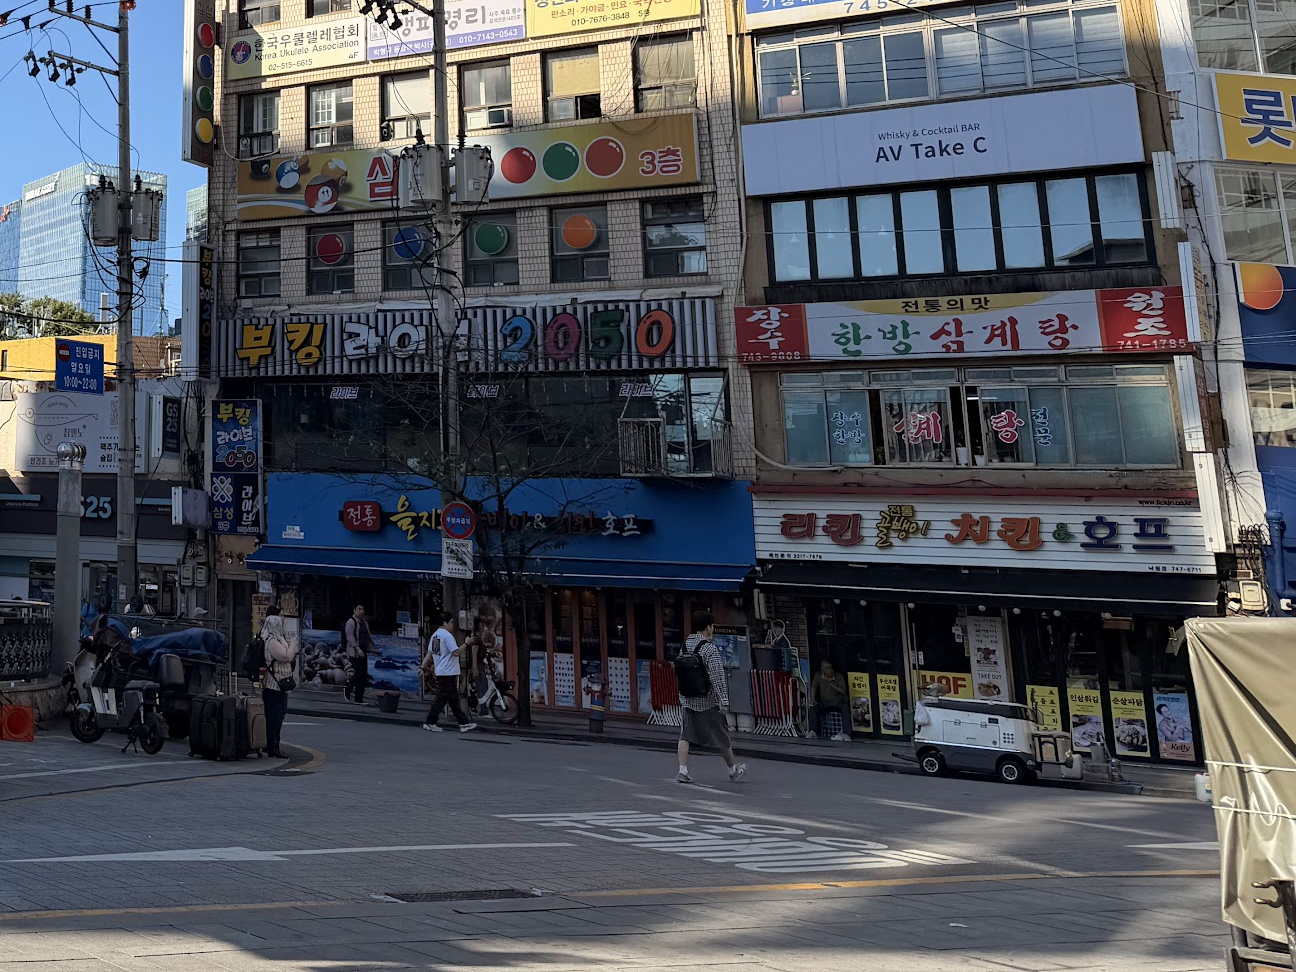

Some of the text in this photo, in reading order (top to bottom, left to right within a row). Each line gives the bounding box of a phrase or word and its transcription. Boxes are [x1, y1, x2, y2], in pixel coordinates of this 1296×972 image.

[551, 7, 575, 19] 판소리
[580, 2, 605, 14] 가야금
[571, 12, 630, 26] 010-7676-3848
[254, 23, 360, 52] 한국우쿨렐레협회
[458, 28, 518, 44] 010-7143-0543
[255, 39, 359, 62] Korea Ukulele Association
[268, 58, 313, 72] 02-515-6615
[1240, 88, 1296, 150] 롯
[878, 123, 980, 141] Whisky & Cocktail BAR
[876, 137, 987, 163] AV Take C
[639, 147, 683, 176] 3층
[1122, 290, 1172, 338] 원조
[236, 322, 326, 367] 부킹
[499, 307, 677, 365] 2050
[747, 307, 790, 350] 장수
[75, 346, 100, 360] 진입금지
[63, 375, 97, 391] 10:00~22:00
[619, 382, 655, 399] 라이브
[330, 386, 359, 400] 라이브
[166, 402, 179, 417] GS
[217, 403, 251, 425] 부킹
[167, 418, 177, 433] 25
[216, 426, 254, 445] 라이브
[100, 453, 112, 464] 술집
[215, 444, 256, 468] 2050
[213, 507, 234, 520] 삼성
[241, 485, 254, 526] 라이브
[346, 495, 642, 541] 전통 을지 & 호프
[446, 516, 471, 525] 주정차금지
[780, 513, 1175, 551] 리킨 치킨 & 호프
[921, 674, 966, 695] HOF
[1070, 694, 1099, 704] 인삼튀김
[1171, 743, 1191, 752] Kelly
